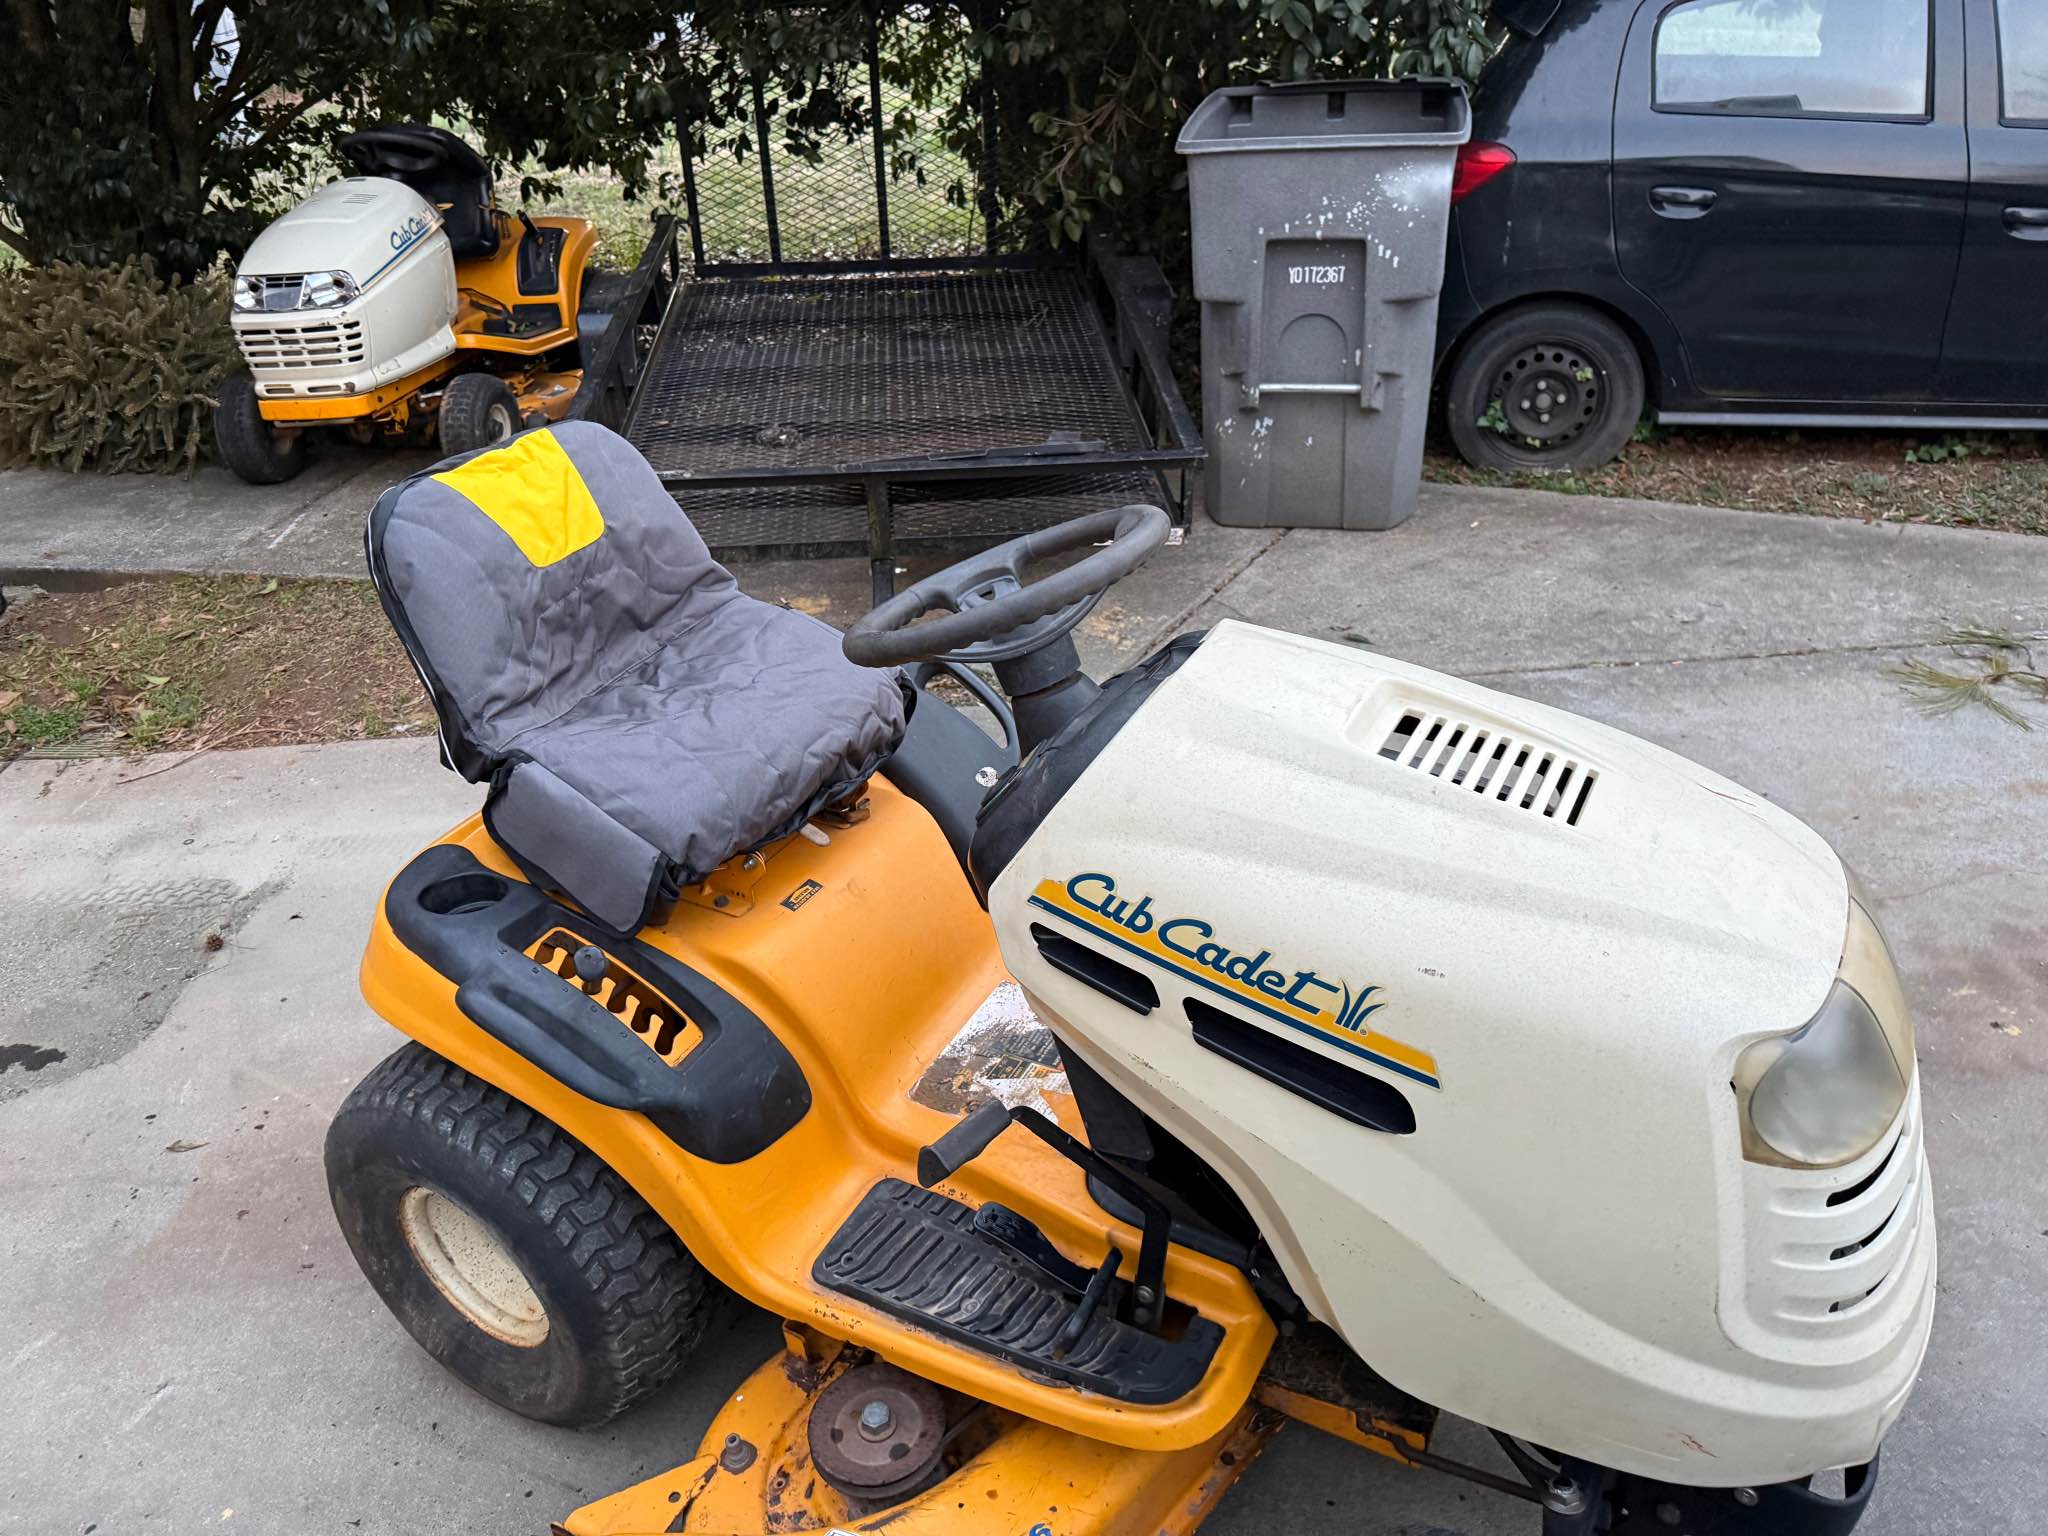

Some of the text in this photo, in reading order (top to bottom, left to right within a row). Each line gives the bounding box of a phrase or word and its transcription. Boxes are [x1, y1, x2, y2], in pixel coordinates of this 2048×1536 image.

[390, 225, 412, 251] Cub
[1066, 872, 1341, 1015] Cub Cadet
